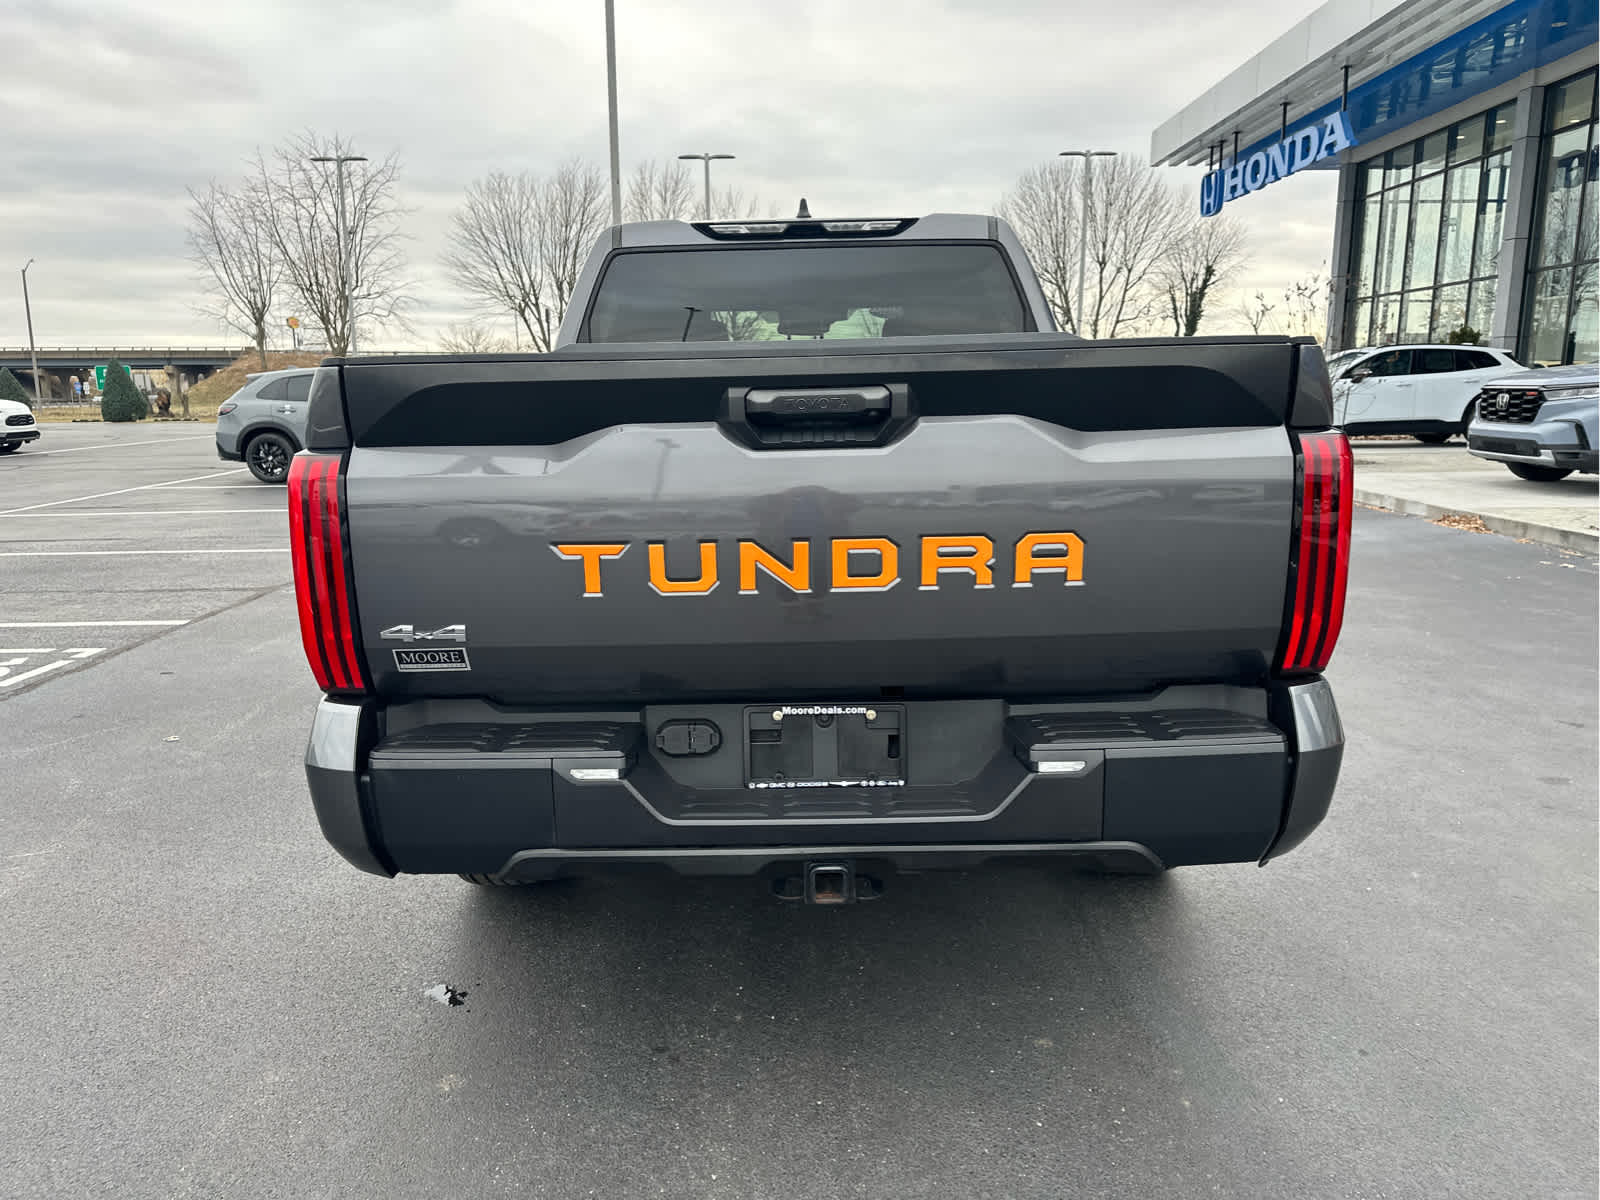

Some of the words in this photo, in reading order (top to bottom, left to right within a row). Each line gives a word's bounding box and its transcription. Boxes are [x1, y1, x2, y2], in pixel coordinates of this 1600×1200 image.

[1223, 111, 1351, 202] HONDA
[784, 397, 849, 410] TOYOTA
[548, 531, 1086, 597] TUNDRA
[380, 624, 466, 642] 4x4
[400, 651, 461, 663] MOORE
[781, 706, 867, 715] MooreDeals.com
